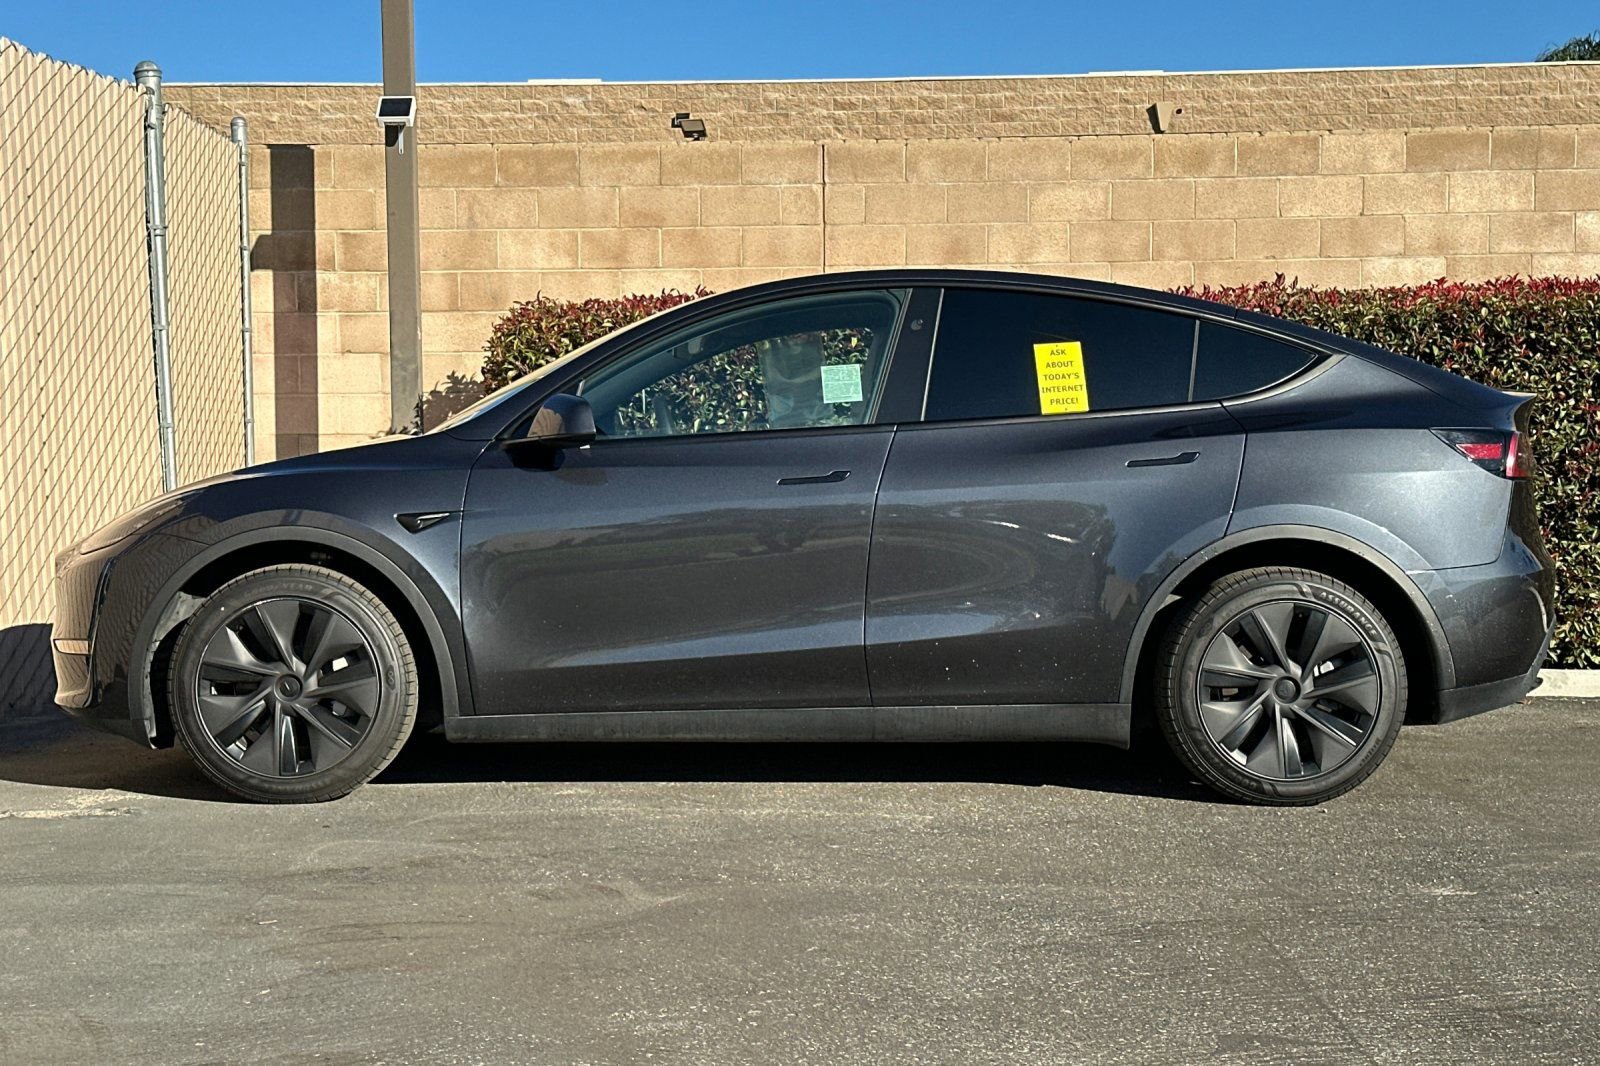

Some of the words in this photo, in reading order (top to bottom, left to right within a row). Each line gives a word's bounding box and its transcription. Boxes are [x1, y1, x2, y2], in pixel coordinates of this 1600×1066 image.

[1043, 372, 1080, 381] TODAY'S
[1042, 384, 1083, 393] INTERNET
[1050, 397, 1079, 405] PRICE!
[1319, 590, 1378, 636] ASSURANCE
